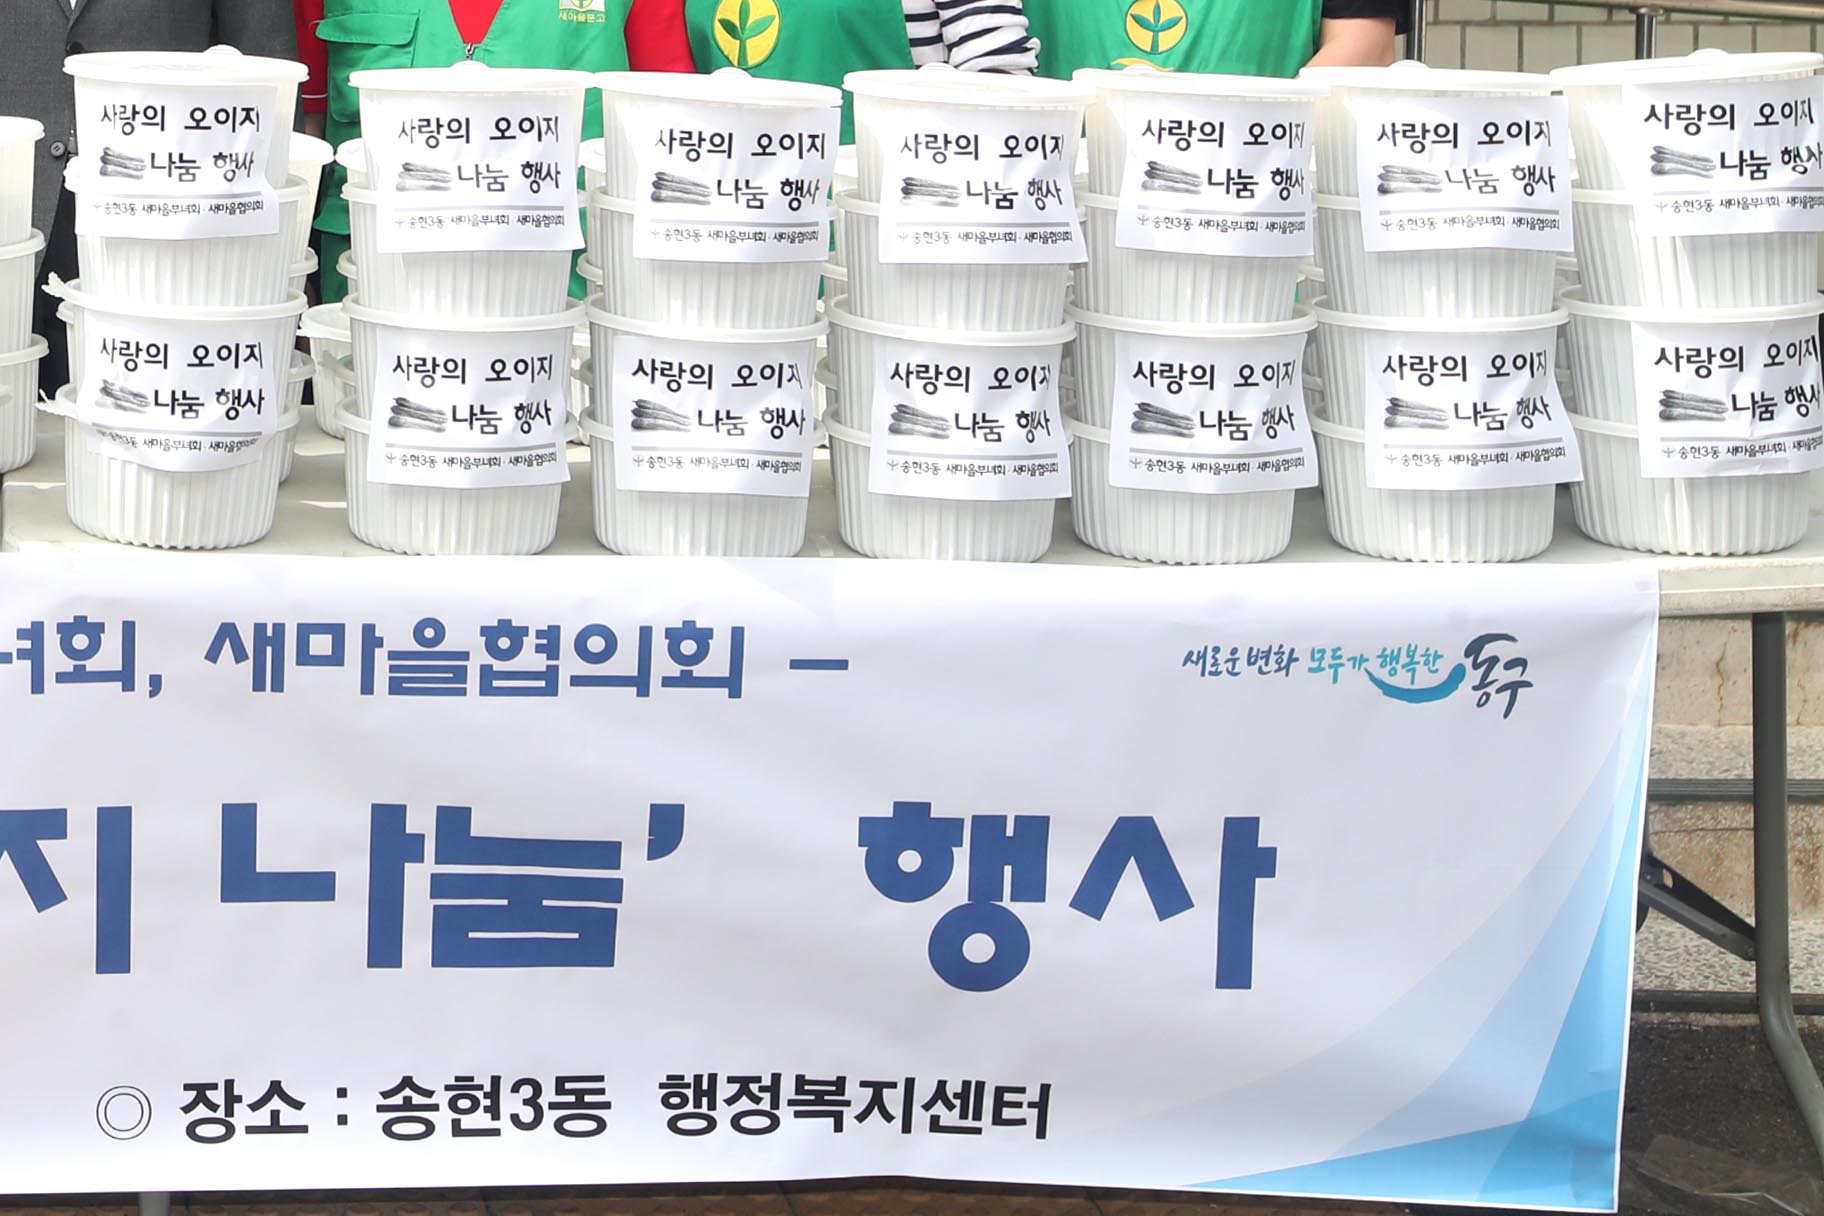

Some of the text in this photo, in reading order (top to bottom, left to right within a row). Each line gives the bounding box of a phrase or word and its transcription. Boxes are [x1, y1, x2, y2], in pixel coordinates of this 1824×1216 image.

[398, 115, 559, 149] 사랑의 오이지
[1141, 118, 1305, 152] 사랑의 오이지
[1377, 119, 1551, 154] 사랑의 오이지
[457, 160, 561, 194] 나눔 행사
[1207, 167, 1305, 202] 나눔 행사
[1444, 164, 1556, 197] 나눔 행사
[392, 354, 553, 389] 사랑의 오이지
[889, 362, 1051, 396] 사랑의 오이지
[451, 399, 552, 435] 나눔 행사
[954, 409, 1051, 444] 나눔 행사
[203, 617, 745, 700] 새마을협의회
[1182, 633, 1534, 719] 새로운 변화 모두가 행복한 동구
[857, 800, 1278, 993] 행사
[179, 1072, 1052, 1145] 장소 송현3동 행정복지센터
